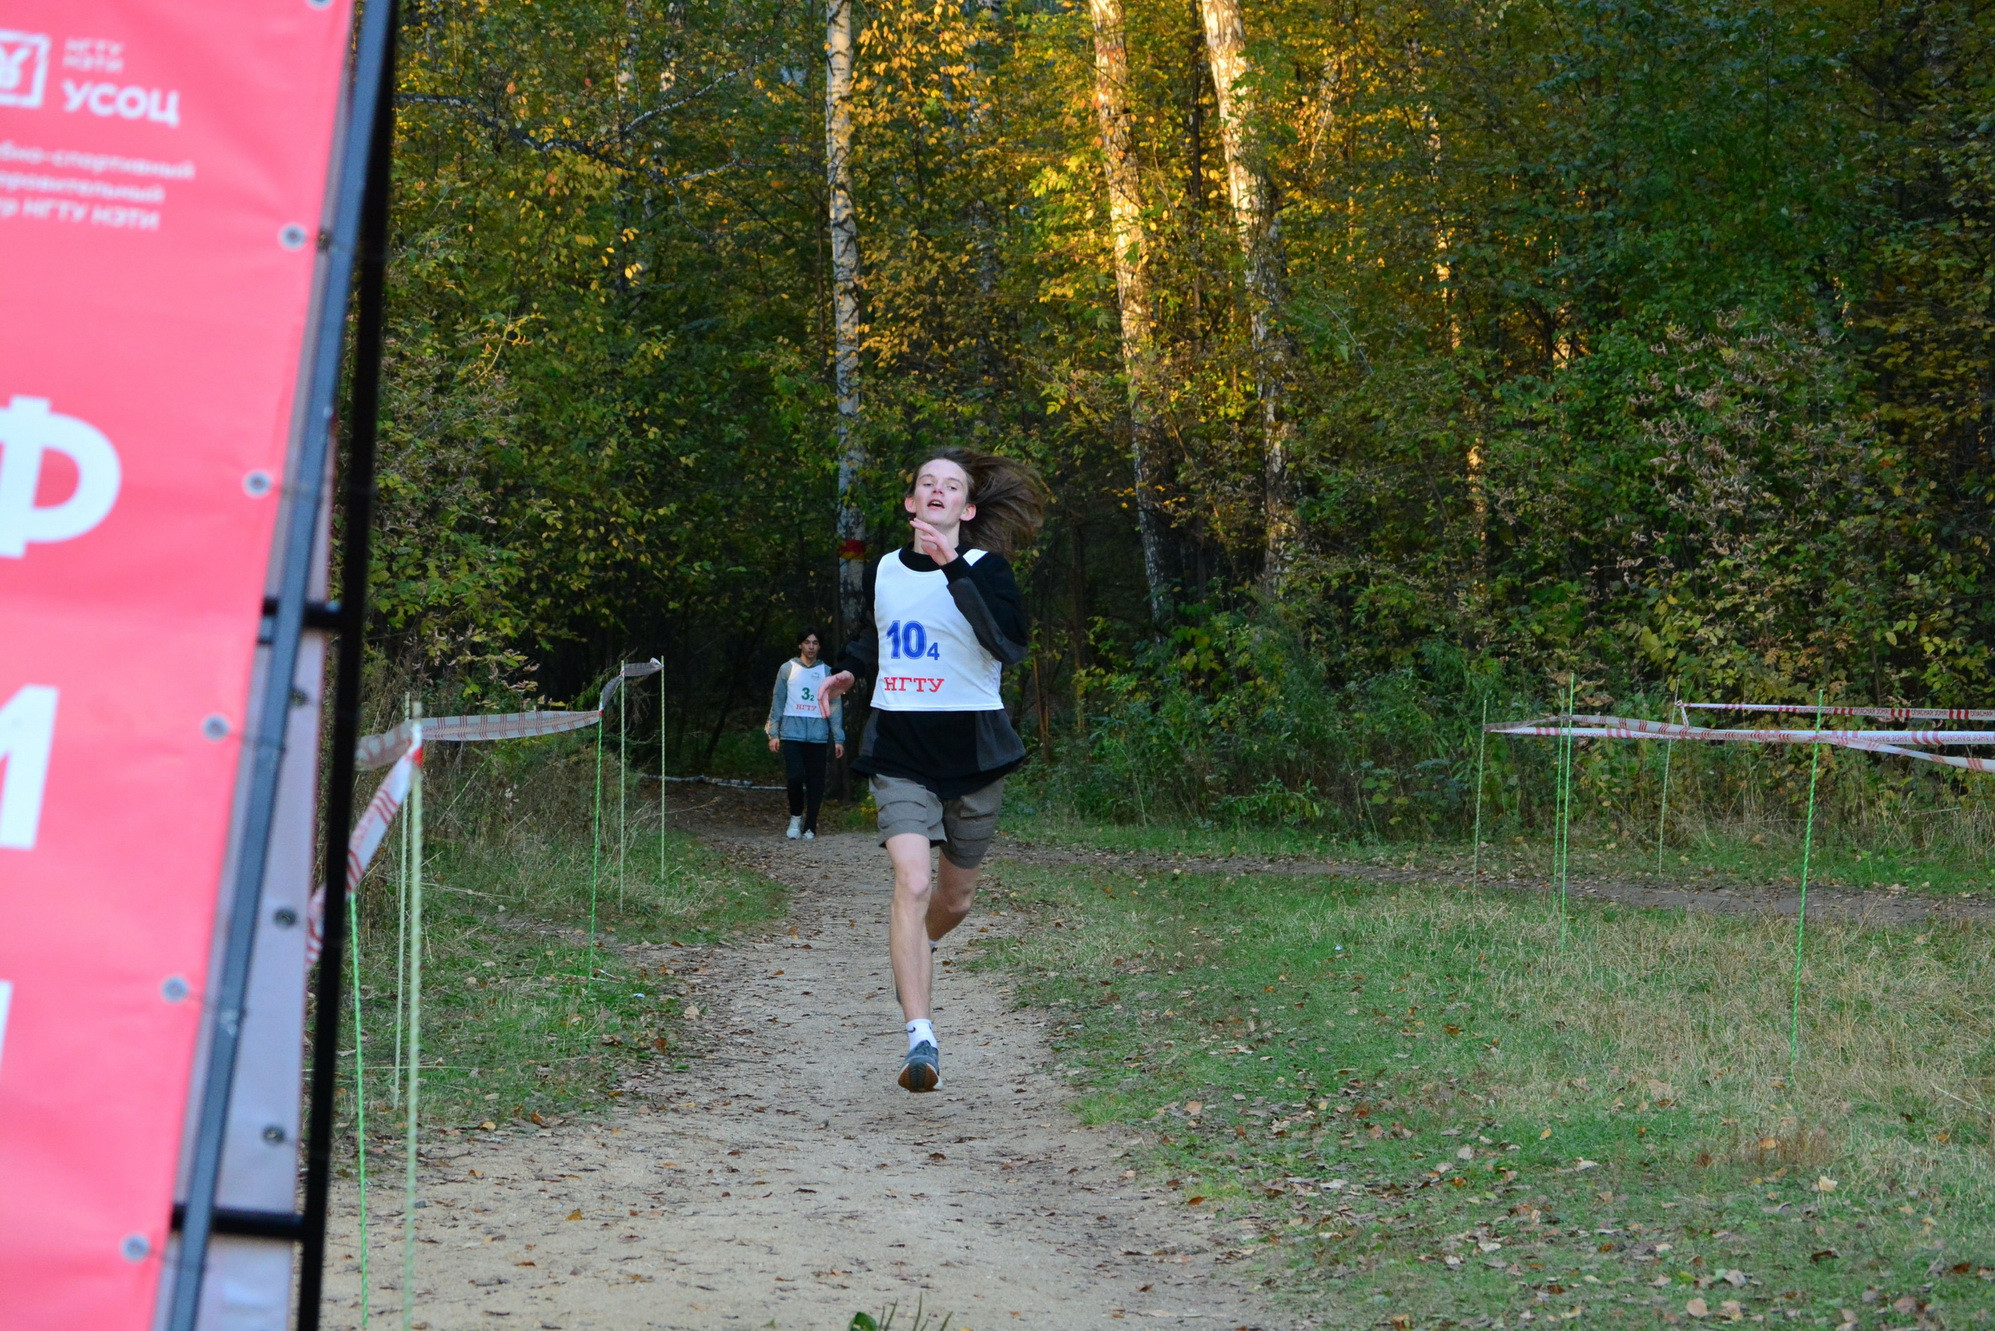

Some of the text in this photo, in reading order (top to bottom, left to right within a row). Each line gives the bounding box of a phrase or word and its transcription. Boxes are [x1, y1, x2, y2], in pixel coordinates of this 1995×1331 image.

[62, 79, 181, 128] УСОЦ
[22, 199, 89, 223] НГТУ
[91, 205, 160, 231] НЭТИ
[884, 677, 945, 693] НГТУ
